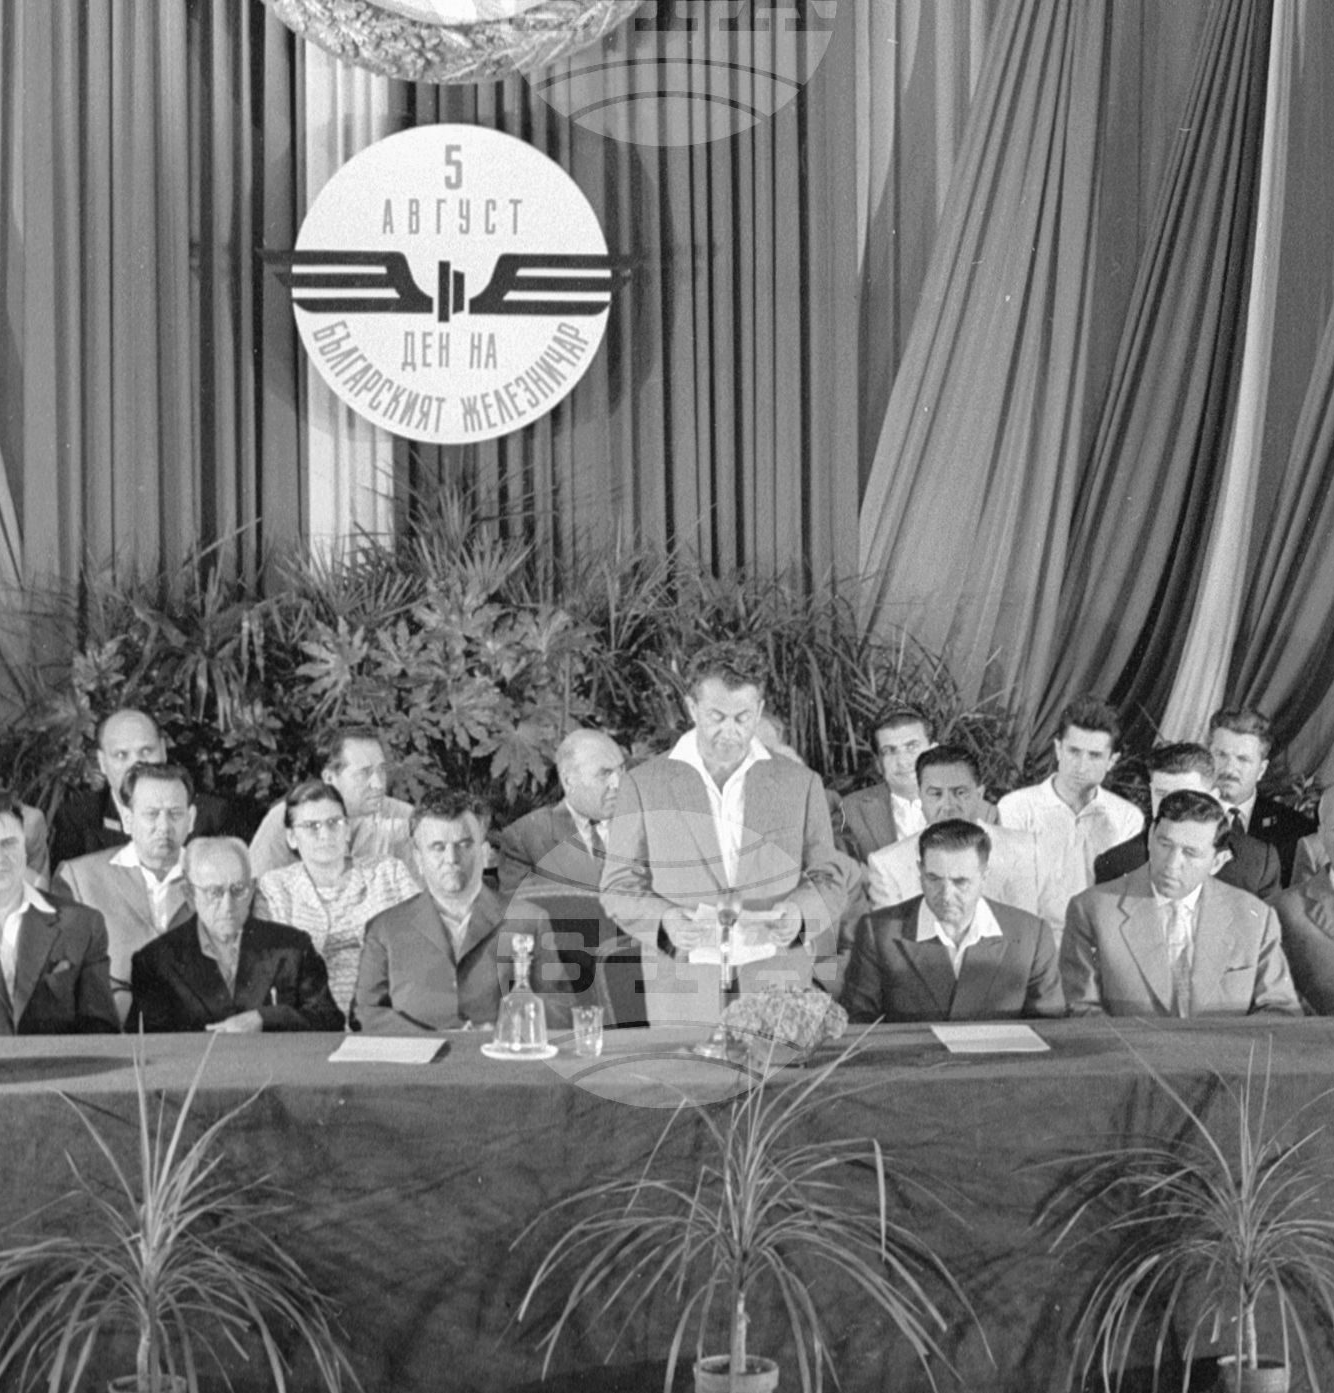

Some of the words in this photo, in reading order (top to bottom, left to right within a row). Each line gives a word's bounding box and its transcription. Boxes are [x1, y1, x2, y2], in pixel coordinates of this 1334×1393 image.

[444, 144, 463, 190] 5
[382, 198, 523, 235] АВГУСТ
[401, 330, 450, 372] ДЕН
[469, 332, 498, 370] НА
[312, 319, 446, 433] БЪЛГАРСКИЯТ
[459, 321, 590, 433] ЖЕЛЕЗНИЧАР
